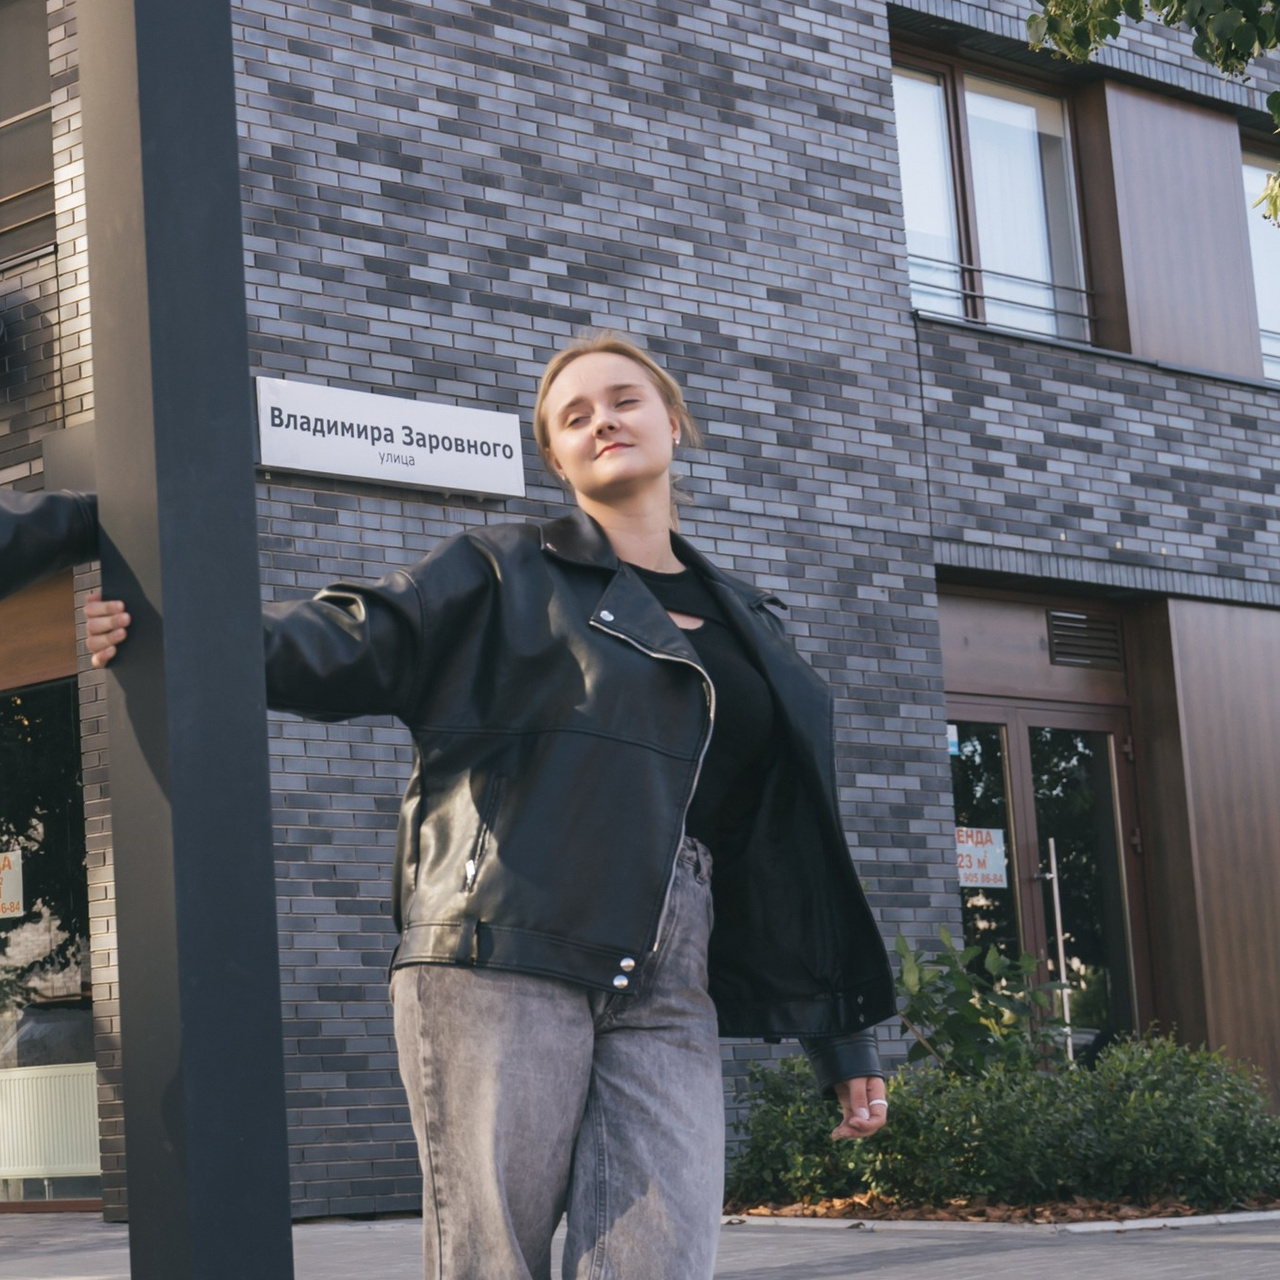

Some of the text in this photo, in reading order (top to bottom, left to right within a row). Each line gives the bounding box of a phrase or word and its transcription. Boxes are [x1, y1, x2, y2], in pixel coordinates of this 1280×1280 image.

[270, 406, 514, 459] Владимира Заровного
[378, 451, 416, 467] улица
[956, 828, 993, 847] ЕНДА
[957, 853, 973, 869] 23
